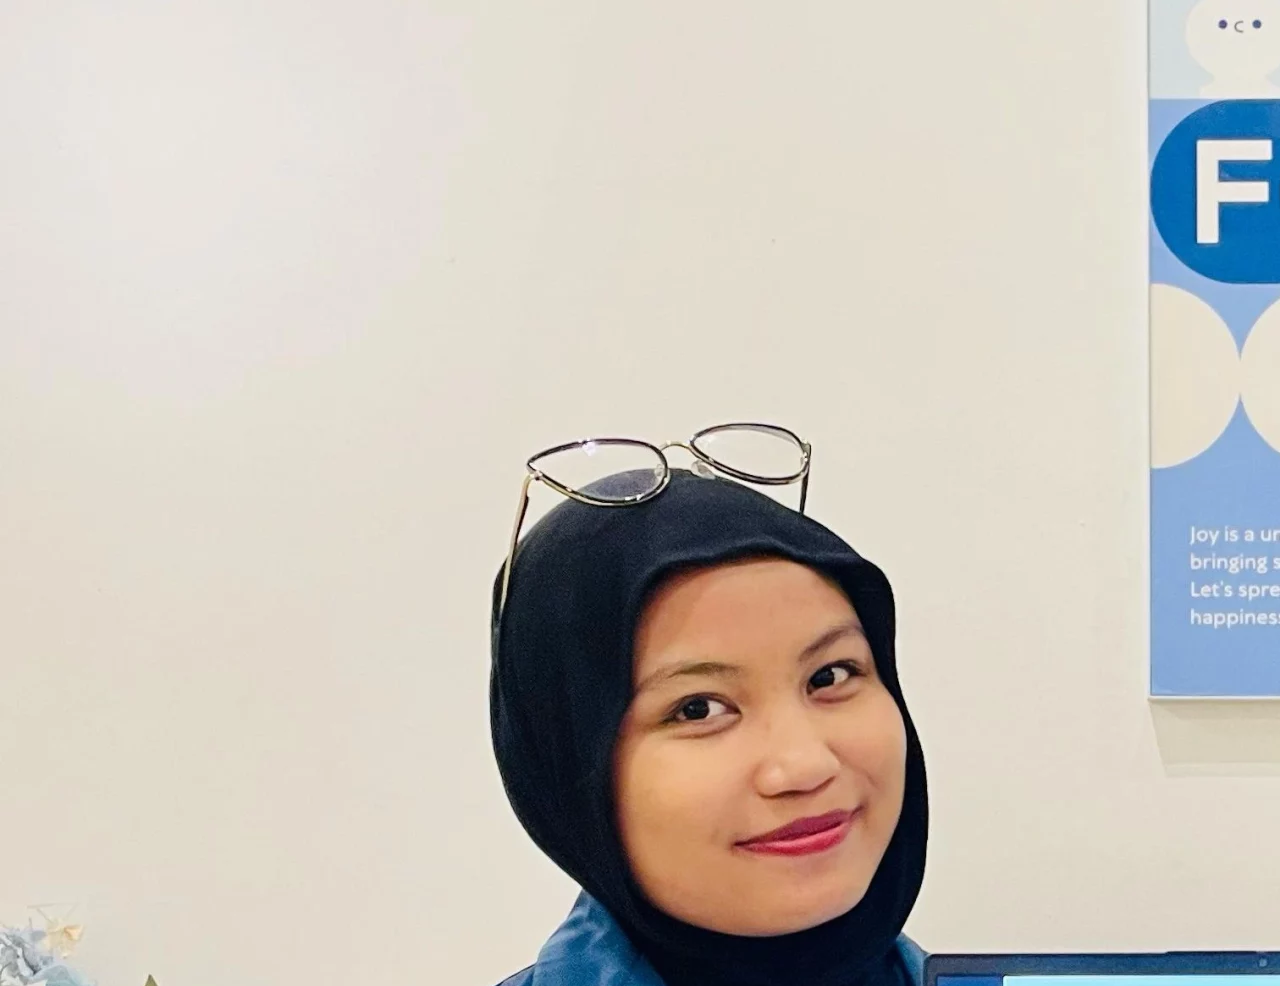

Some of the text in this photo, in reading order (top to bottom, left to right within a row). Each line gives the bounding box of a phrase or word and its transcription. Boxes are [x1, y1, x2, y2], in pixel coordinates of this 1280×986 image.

[1189, 526, 1219, 546] Joy
[1224, 525, 1239, 542] is
[1244, 529, 1255, 542] a
[1190, 552, 1268, 574] bringing
[1190, 581, 1233, 598] Let's
